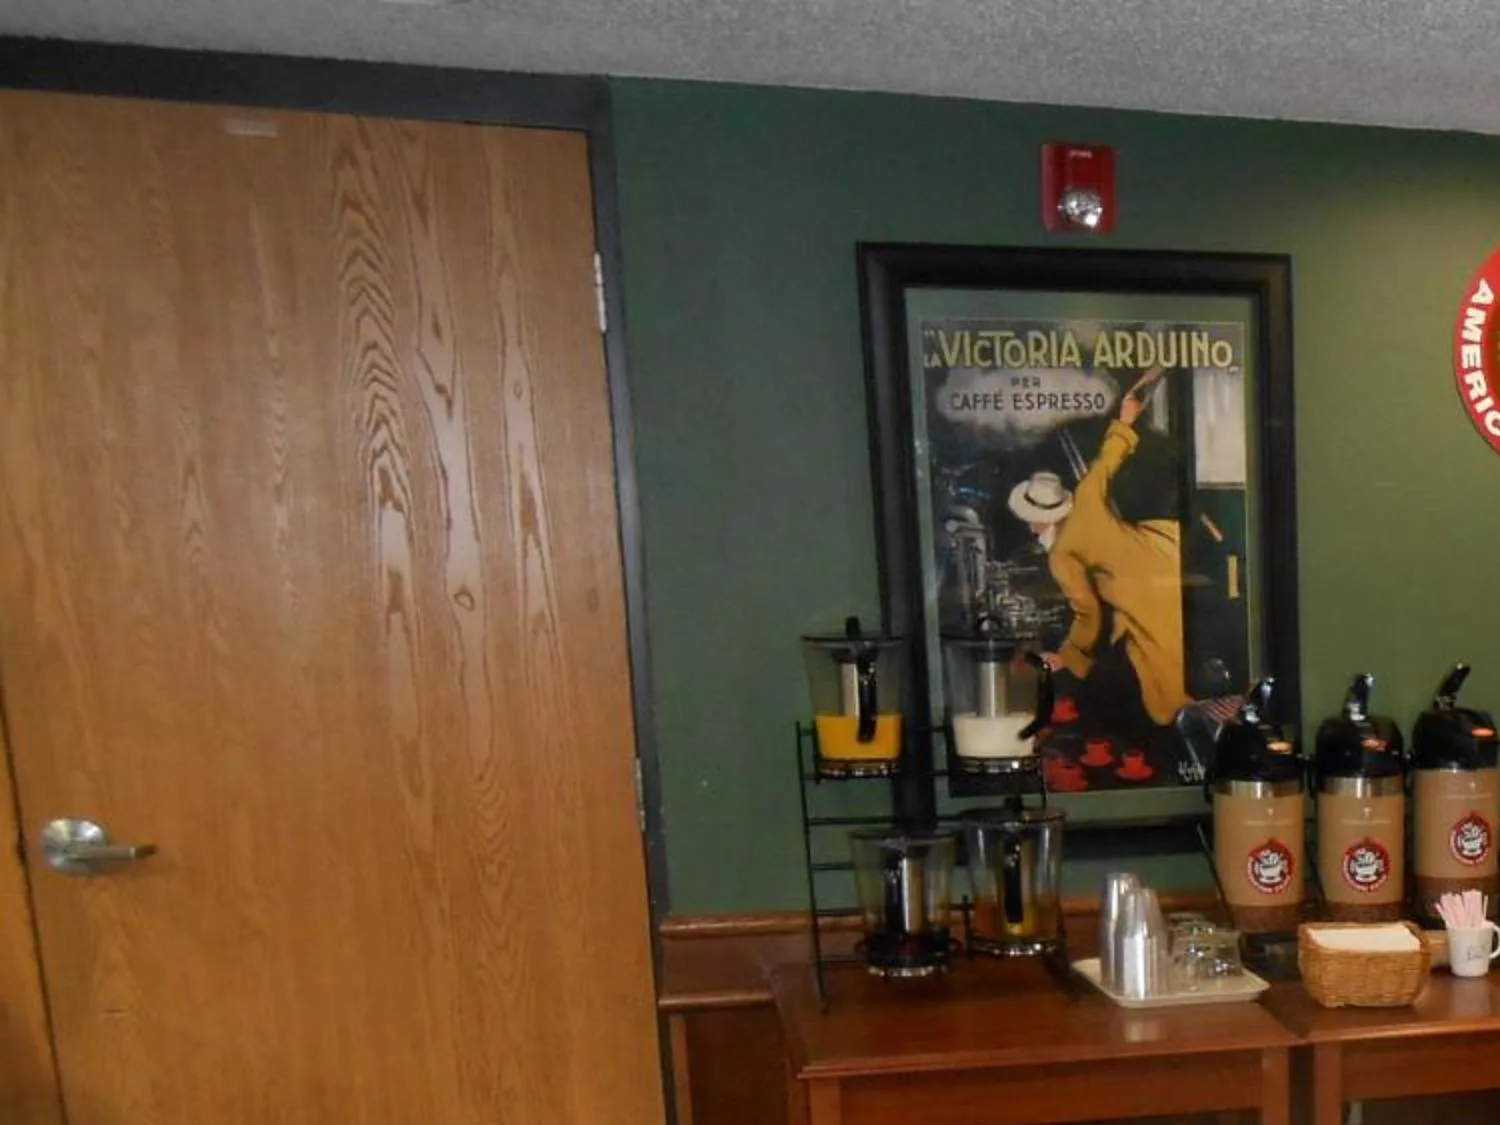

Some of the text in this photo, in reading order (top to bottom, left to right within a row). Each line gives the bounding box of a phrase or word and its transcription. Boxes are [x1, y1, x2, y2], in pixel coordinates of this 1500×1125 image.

[937, 329, 1082, 368] VICTORIA
[1010, 376, 1042, 389] PER
[1012, 391, 1106, 411] ESPRESSO
